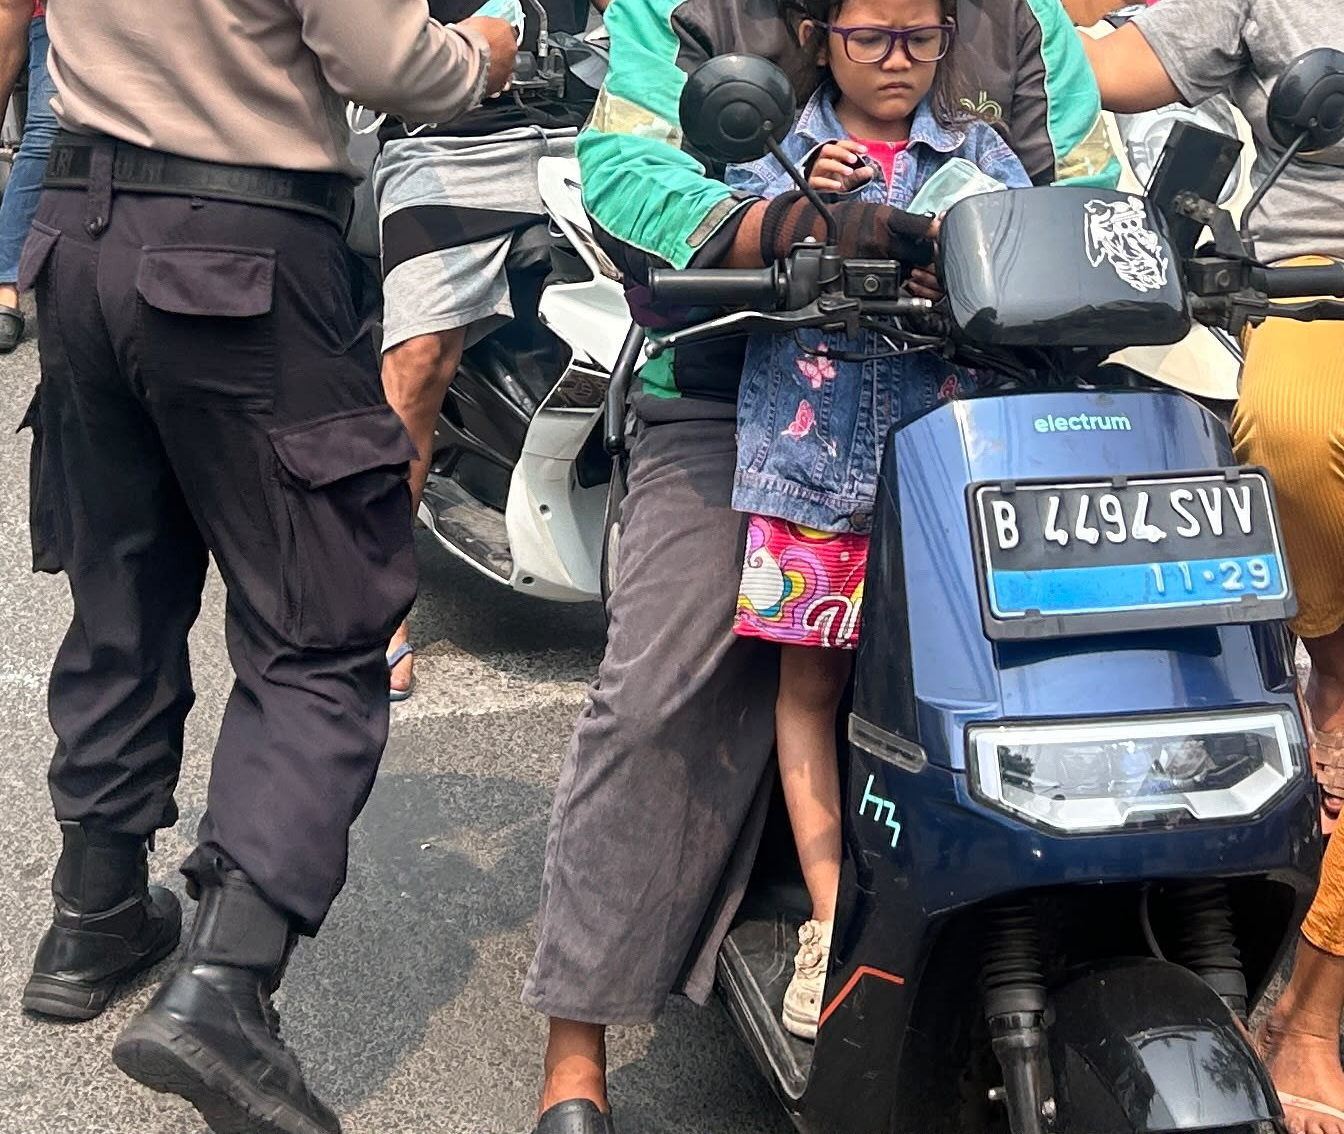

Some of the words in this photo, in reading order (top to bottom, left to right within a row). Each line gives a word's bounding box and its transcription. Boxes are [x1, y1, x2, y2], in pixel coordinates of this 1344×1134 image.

[1034, 413, 1132, 433] electrum
[992, 500, 1020, 550] B
[1044, 490, 1168, 546] 4494
[1169, 485, 1253, 538] SVV
